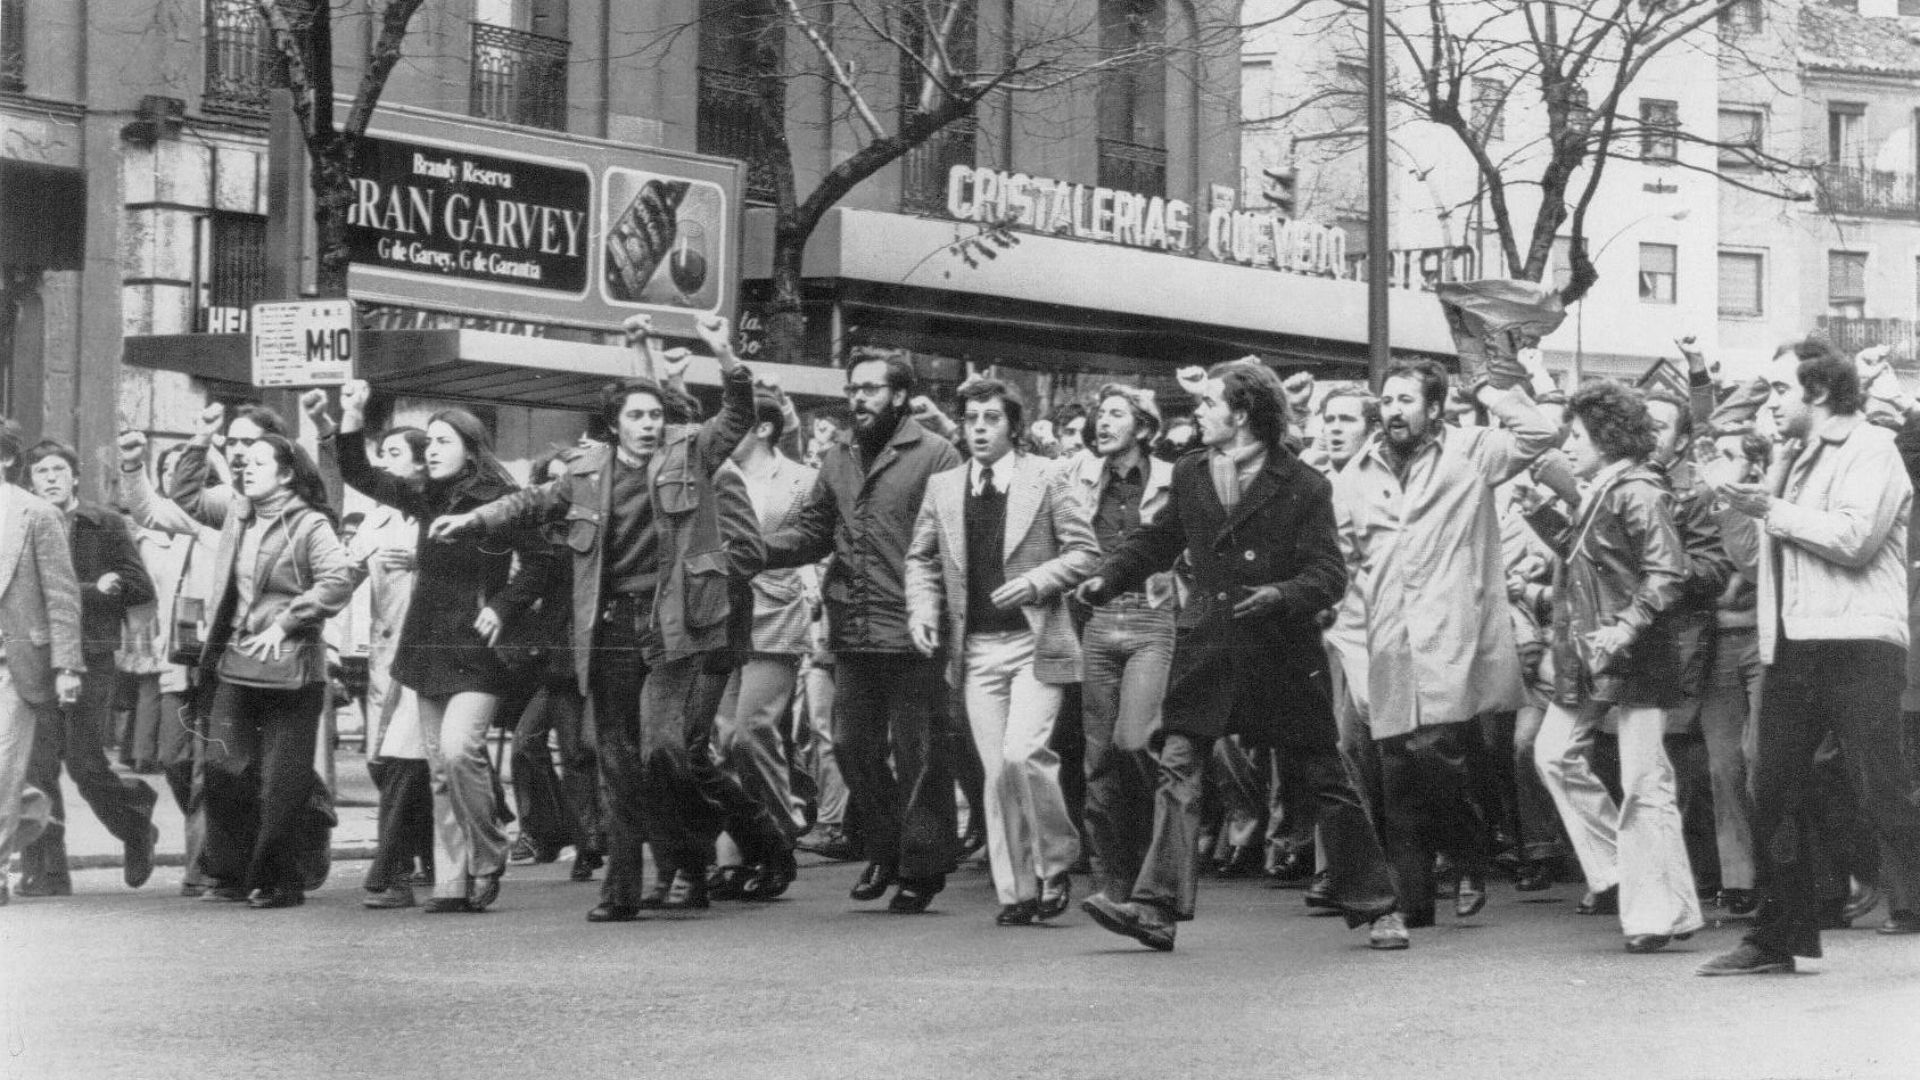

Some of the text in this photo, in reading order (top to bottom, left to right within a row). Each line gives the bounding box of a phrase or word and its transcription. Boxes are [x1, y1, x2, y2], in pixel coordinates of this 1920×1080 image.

[413, 153, 512, 188] Brandy Reserva
[444, 193, 585, 257] GARVEY
[948, 165, 1192, 251] CRISTALERIAS
[1207, 207, 1346, 280] QUEVEDO
[378, 237, 391, 259] G
[392, 239, 407, 261] de
[460, 249, 472, 270] G
[473, 251, 487, 272] de
[306, 328, 351, 362] M-10
